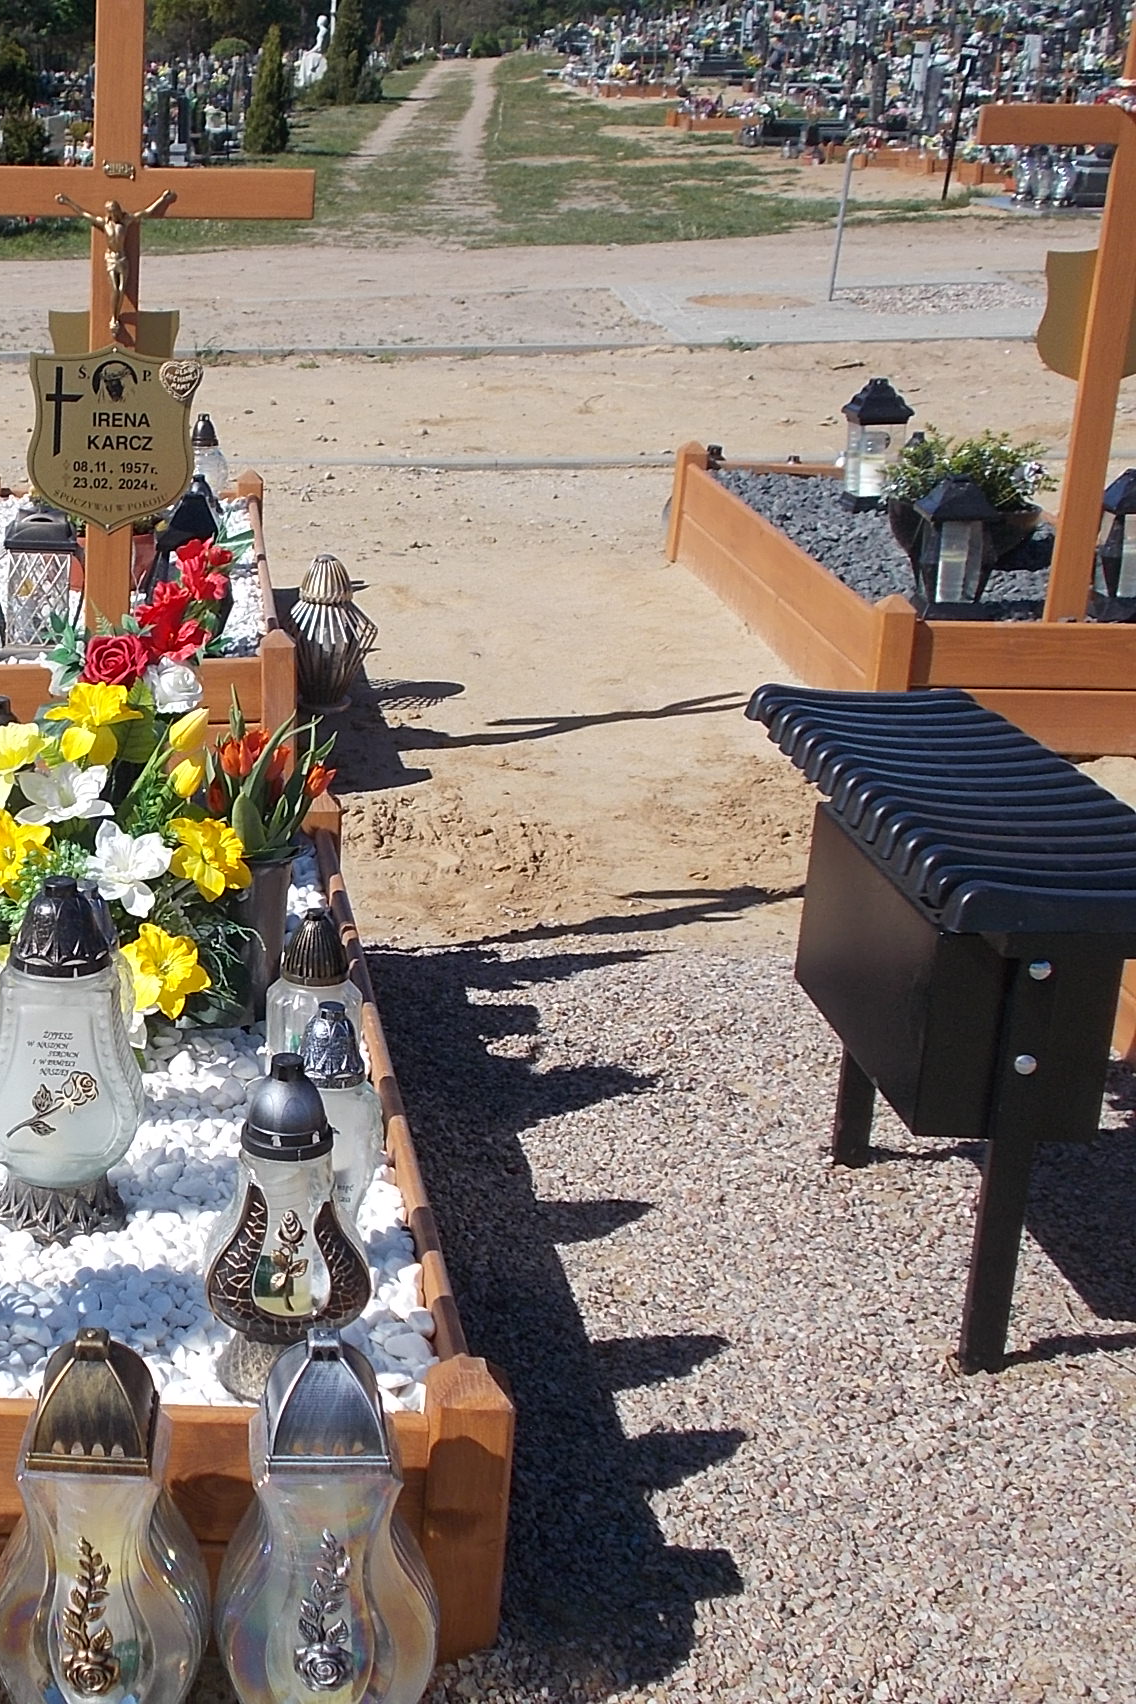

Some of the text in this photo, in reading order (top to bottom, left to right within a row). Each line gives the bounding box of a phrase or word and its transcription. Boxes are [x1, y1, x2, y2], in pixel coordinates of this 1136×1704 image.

[142, 370, 152, 382] P.
[92, 412, 151, 428] IRENA
[87, 434, 154, 451] KARCZ
[53, 489, 112, 513] SPOCZYWAJ
